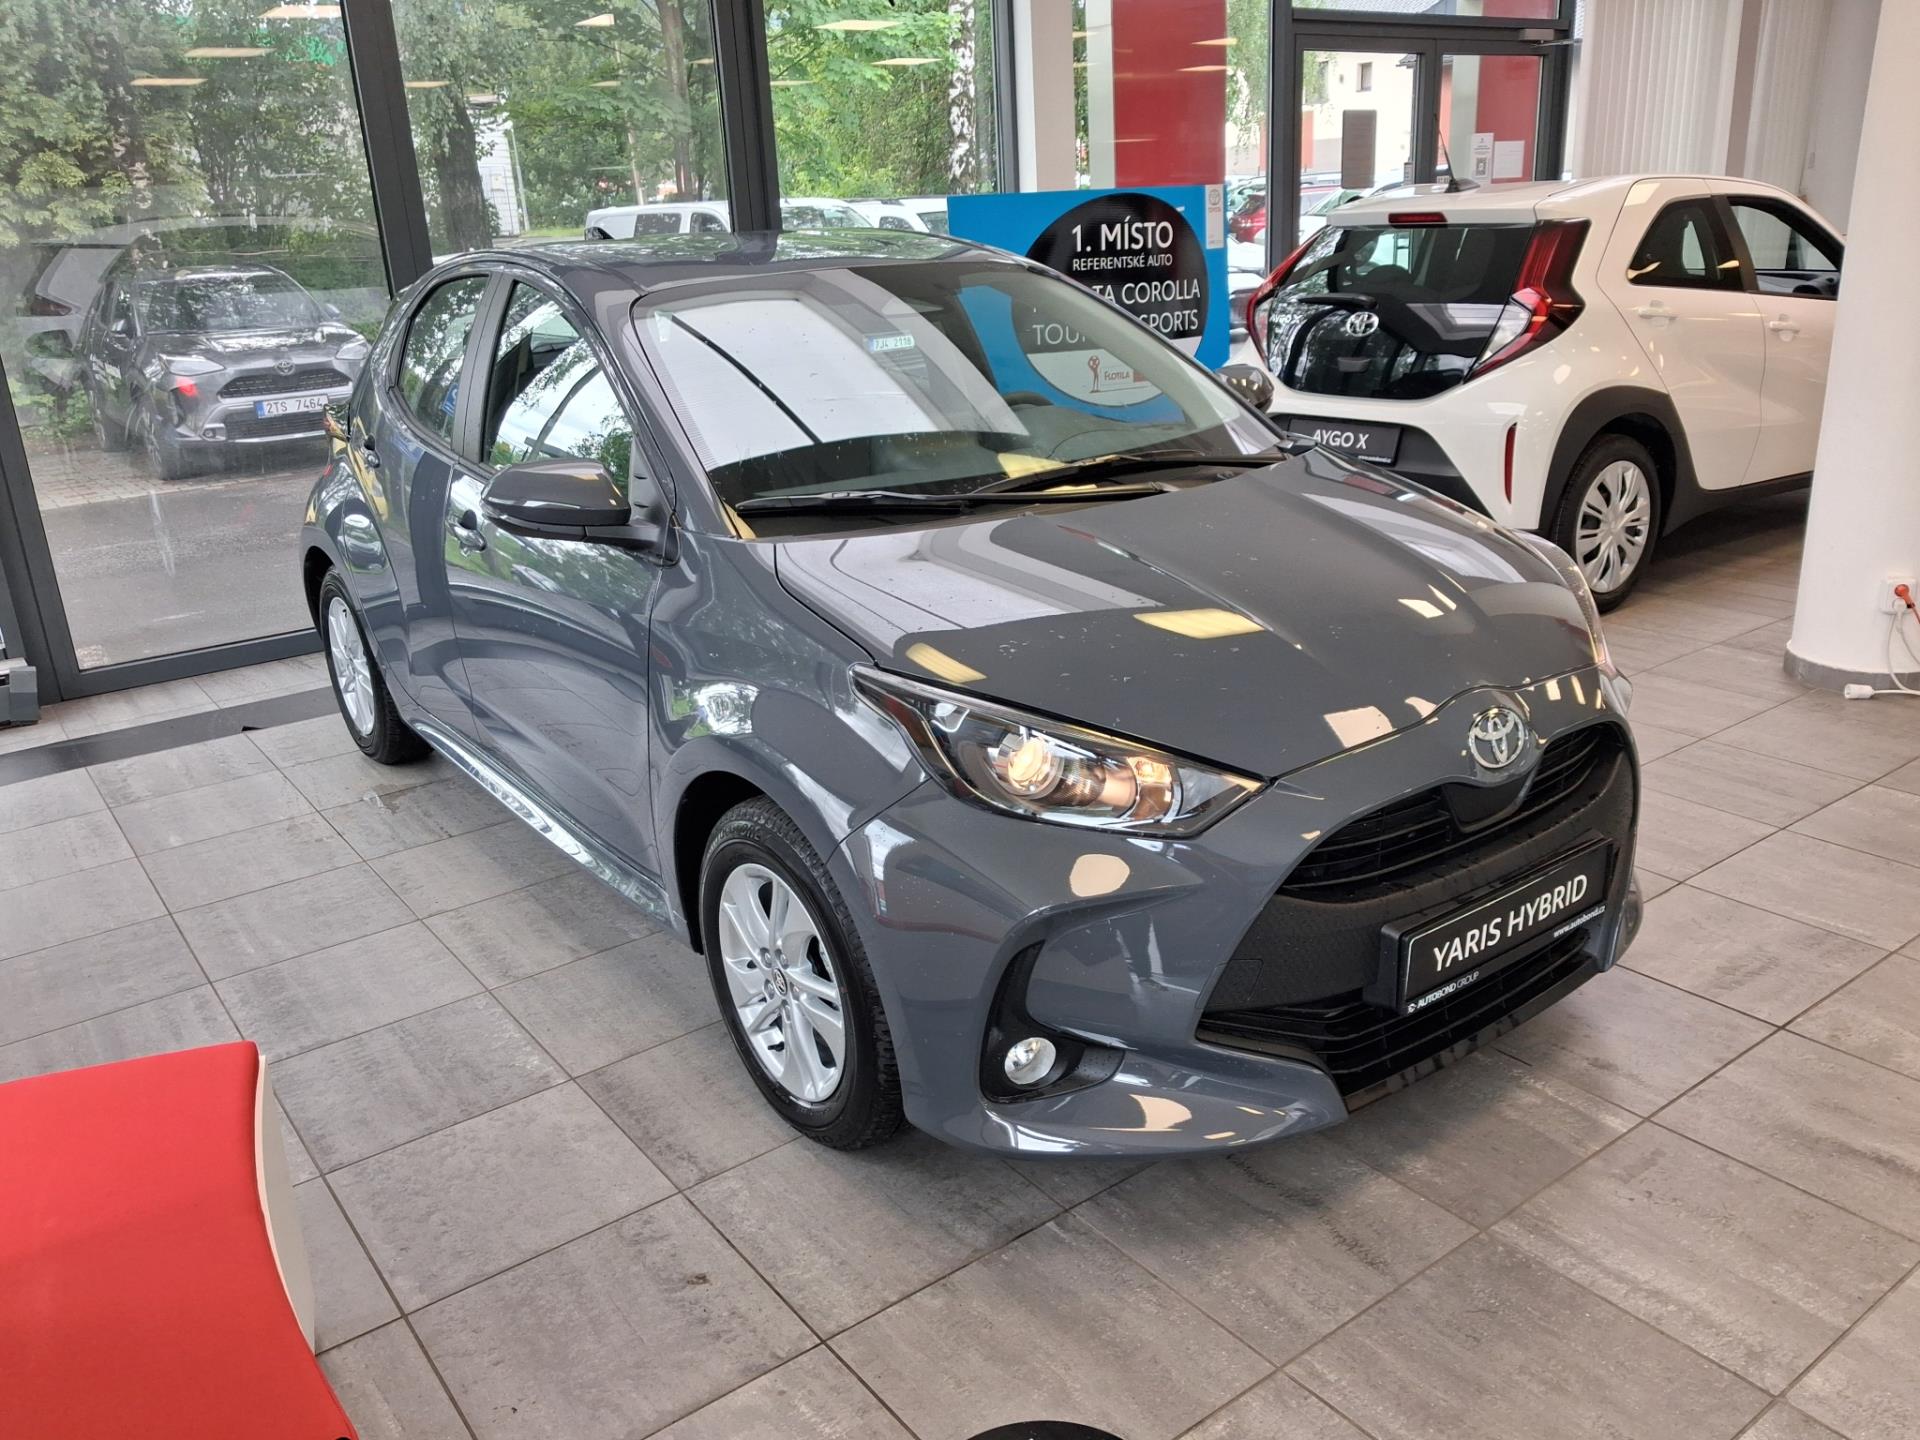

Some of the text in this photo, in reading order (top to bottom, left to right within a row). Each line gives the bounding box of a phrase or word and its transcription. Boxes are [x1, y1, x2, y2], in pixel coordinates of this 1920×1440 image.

[1072, 215, 1174, 253] 1. MÍSTO
[1072, 252, 1173, 271] REFERENTSKÉ AUTO
[1121, 278, 1201, 305] COROLLA
[1032, 323, 1086, 346] TOU
[266, 397, 323, 414] 2TS 7464
[1313, 428, 1370, 450] AYGO X
[1433, 874, 1588, 972] YARIS HYBRID
[1417, 970, 1480, 1009] AUTOBOND GROUP
